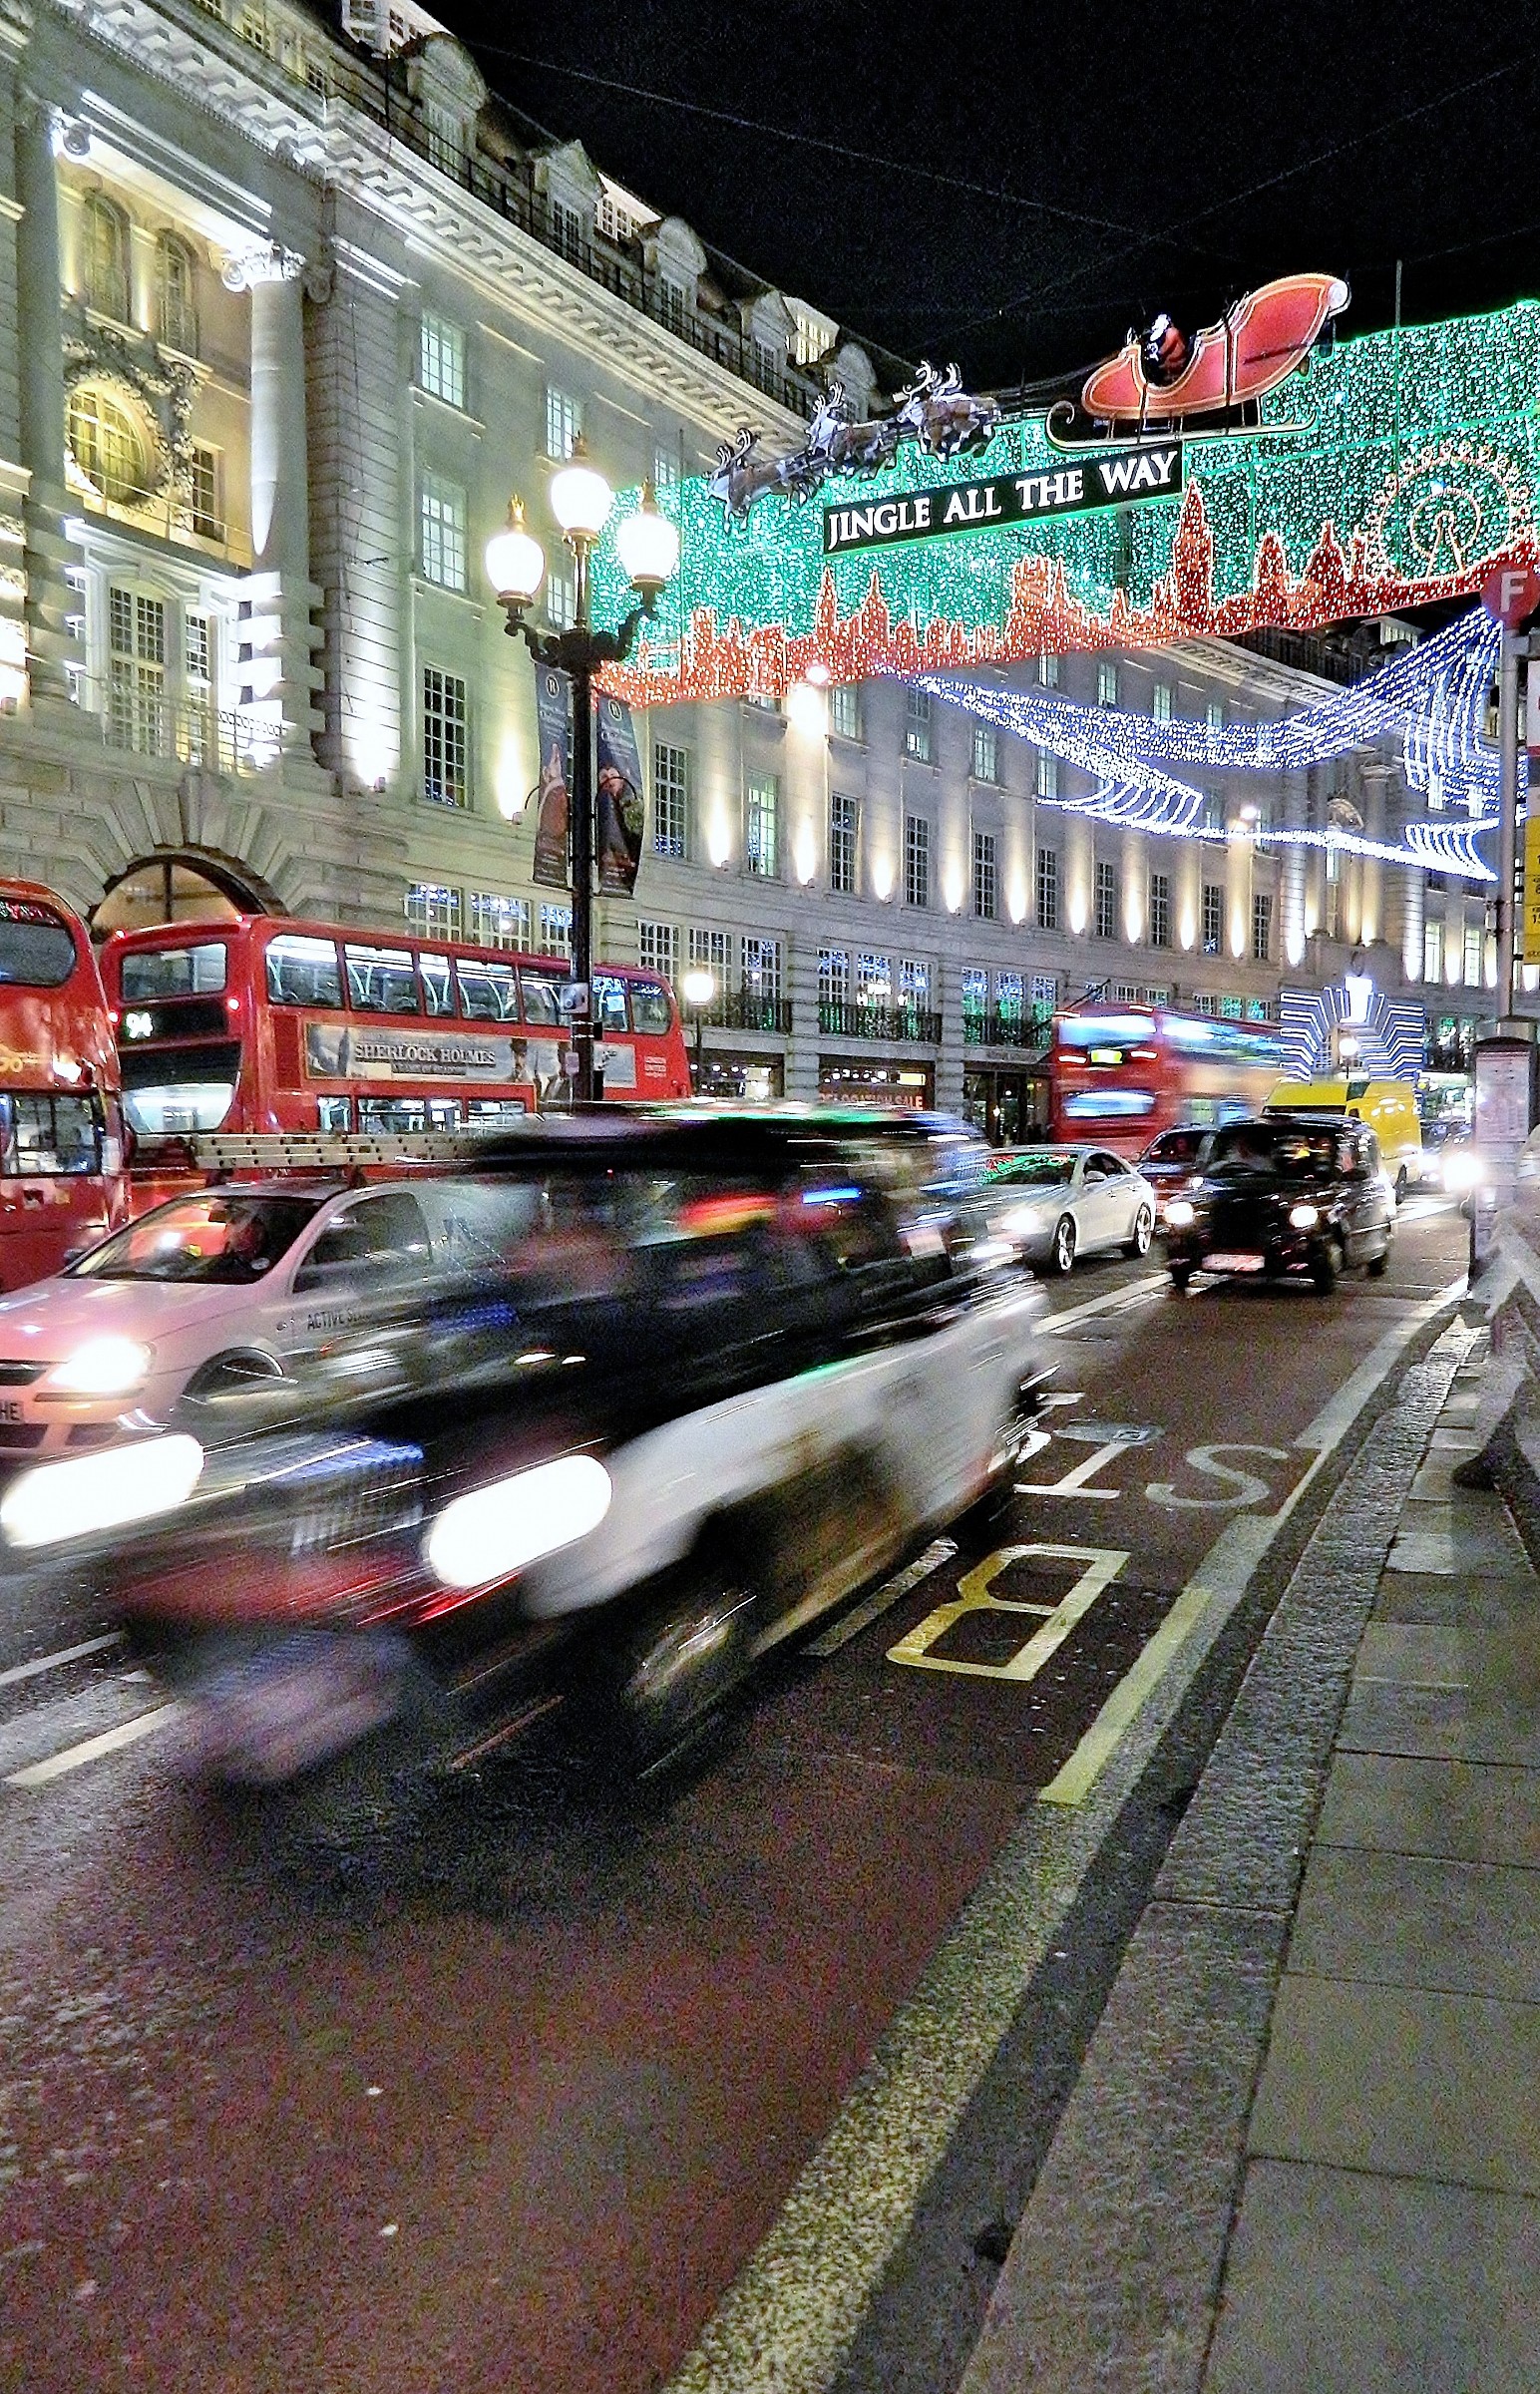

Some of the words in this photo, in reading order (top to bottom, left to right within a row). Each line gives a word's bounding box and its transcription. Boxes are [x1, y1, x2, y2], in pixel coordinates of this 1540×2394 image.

[827, 498, 931, 549] JINGLE
[943, 487, 1001, 524] ALL
[1014, 468, 1084, 511] THE
[1099, 451, 1178, 494] WAY
[1499, 570, 1528, 613] F
[126, 1011, 154, 1039] 94
[355, 1042, 437, 1062] SHERLOCK
[439, 1046, 496, 1064] HOLMES
[306, 1311, 346, 1332] ACTIVE
